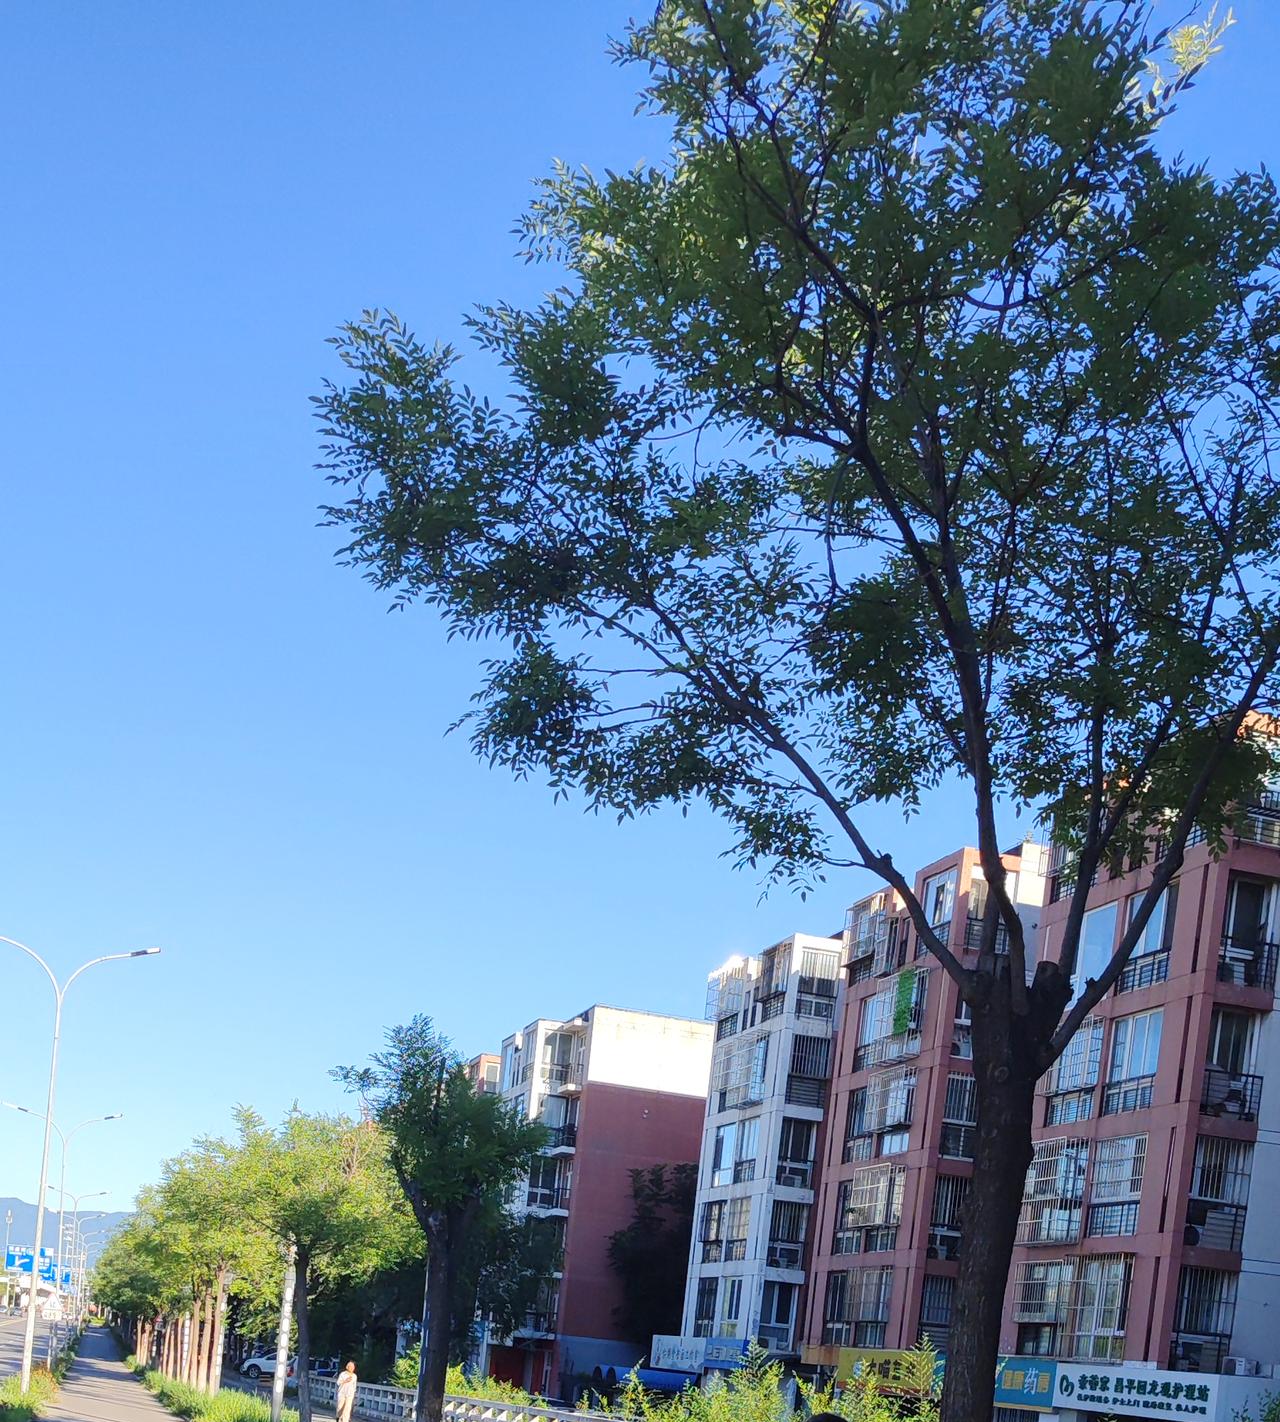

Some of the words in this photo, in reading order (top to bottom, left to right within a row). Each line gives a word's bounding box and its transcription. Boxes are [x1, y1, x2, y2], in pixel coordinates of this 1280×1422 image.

[1114, 1377, 1210, 1402] 昌平回龙观护理站
